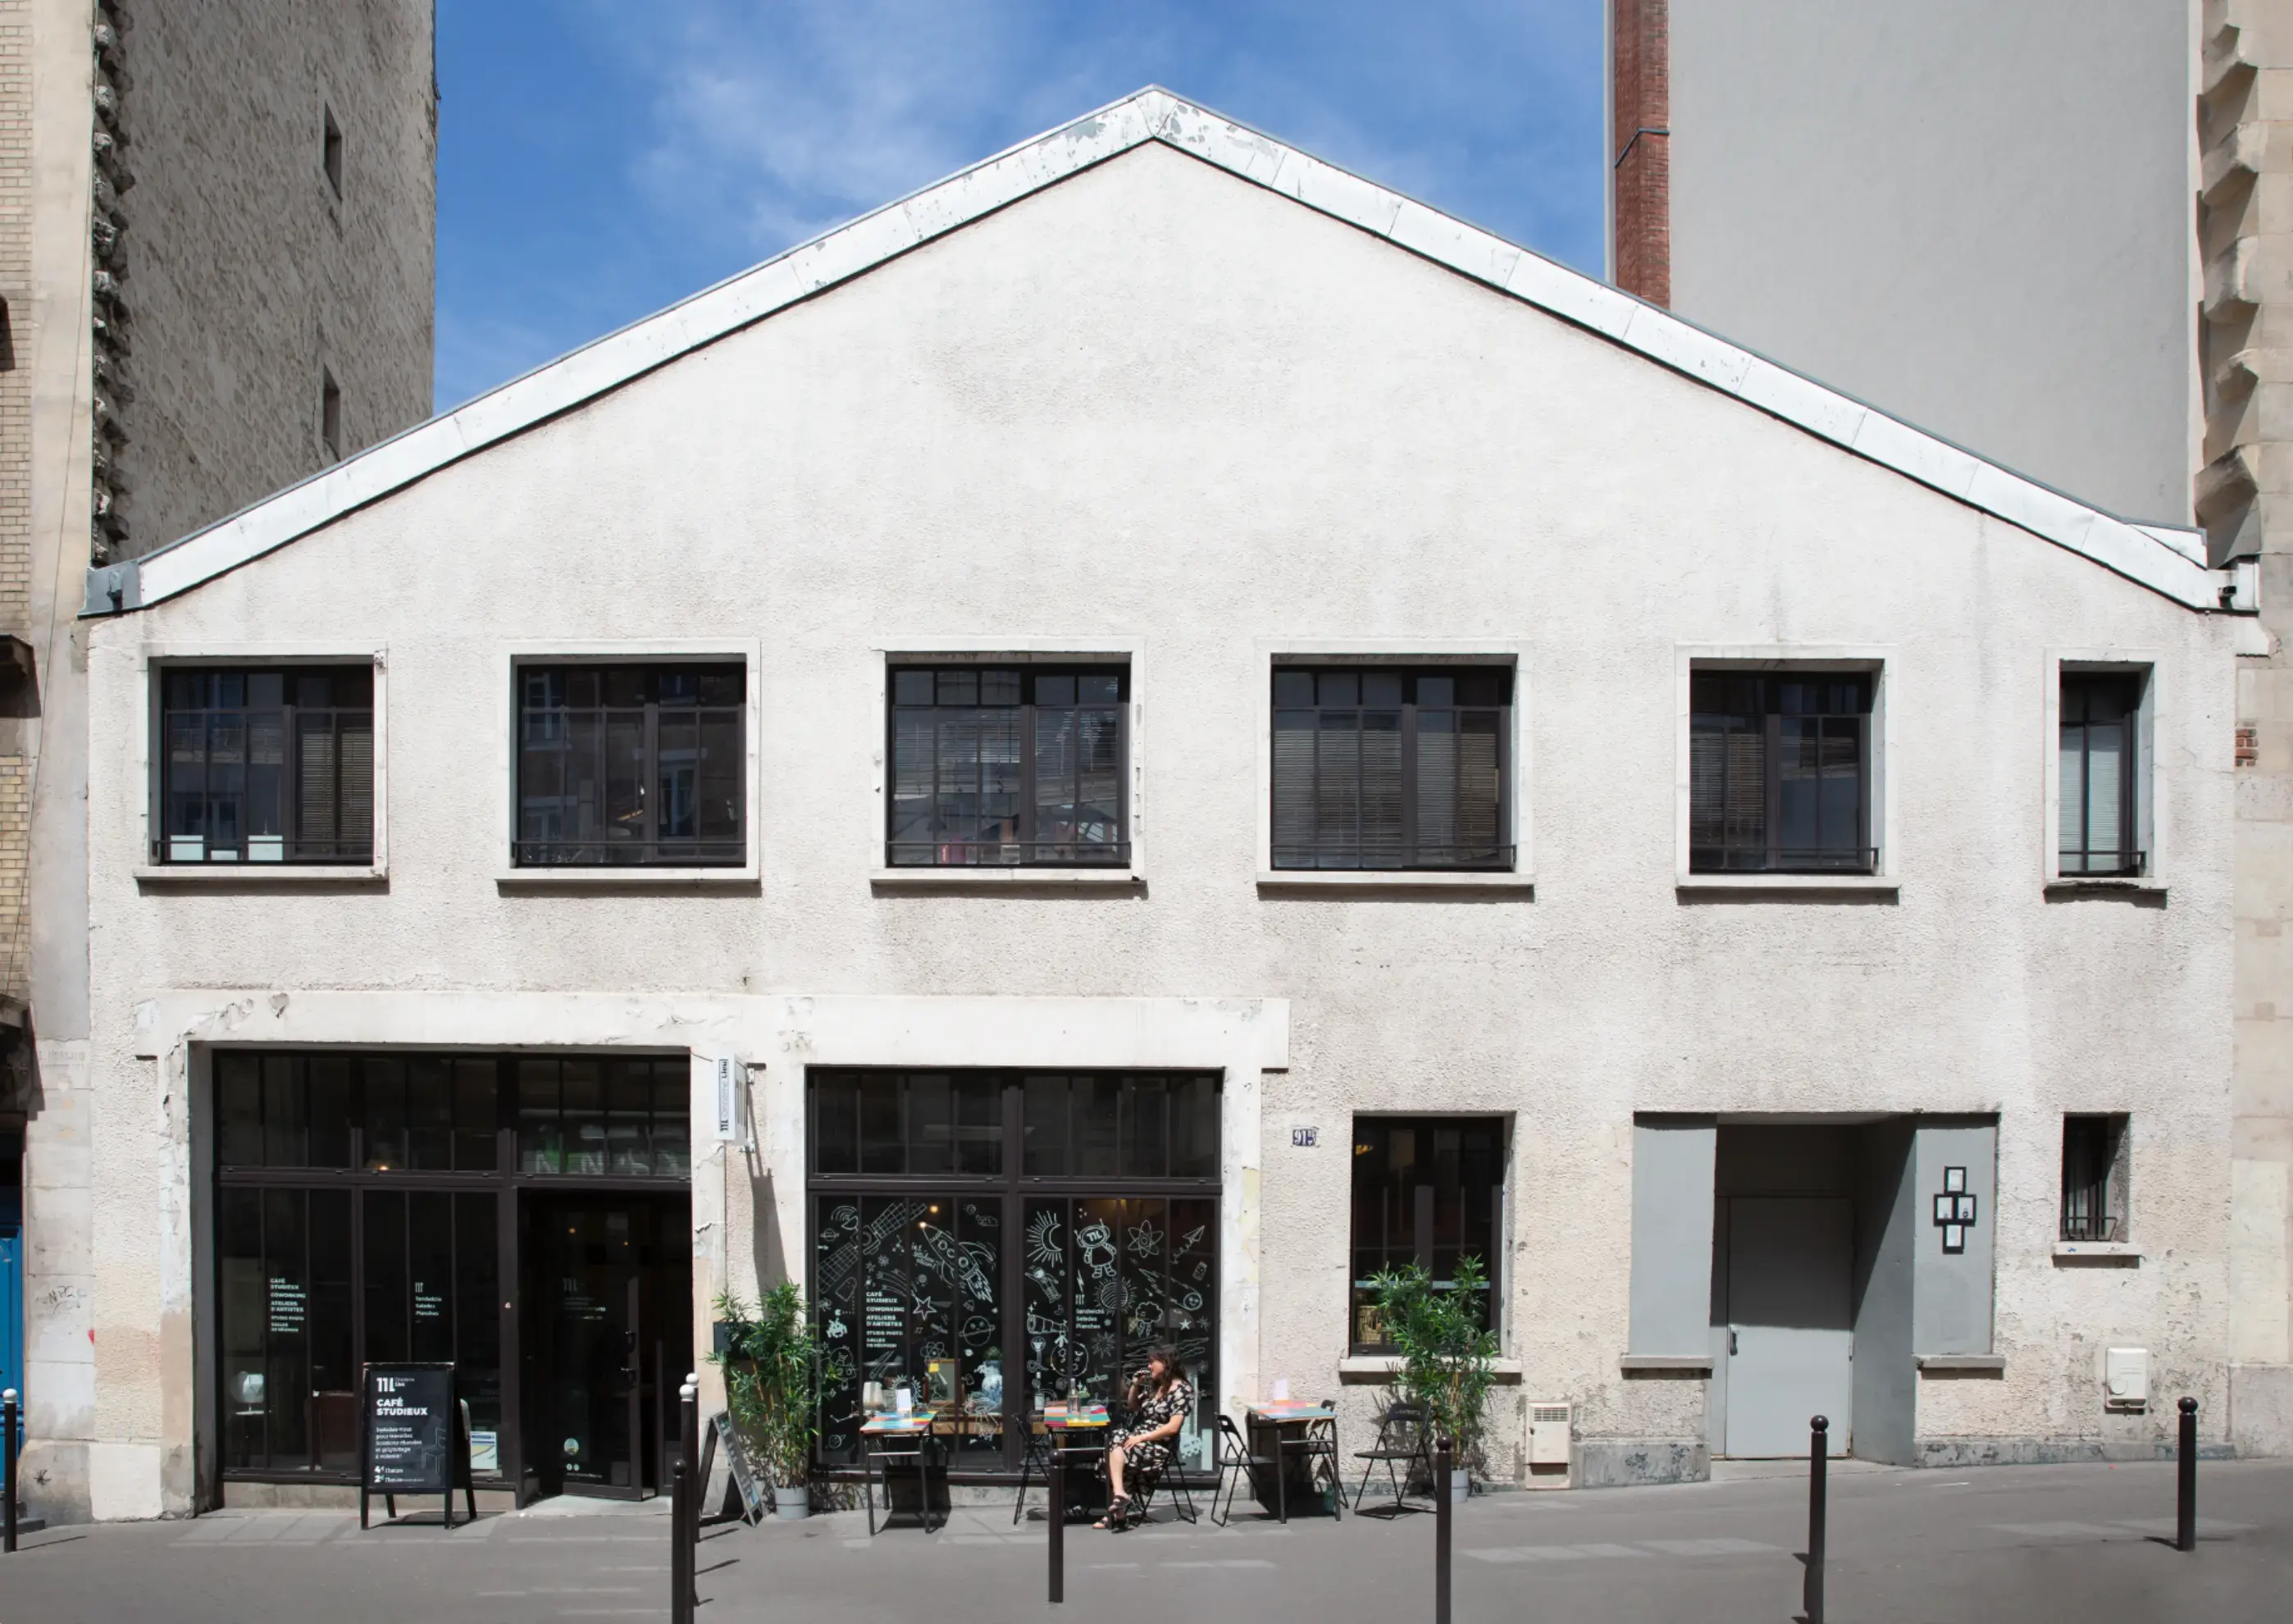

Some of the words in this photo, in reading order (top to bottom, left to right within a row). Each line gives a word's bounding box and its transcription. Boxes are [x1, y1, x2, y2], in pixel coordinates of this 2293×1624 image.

[376, 1377, 395, 1392] 11L
[376, 1396, 403, 1407] CAFÉ
[376, 1407, 428, 1416] STUDIEUX
